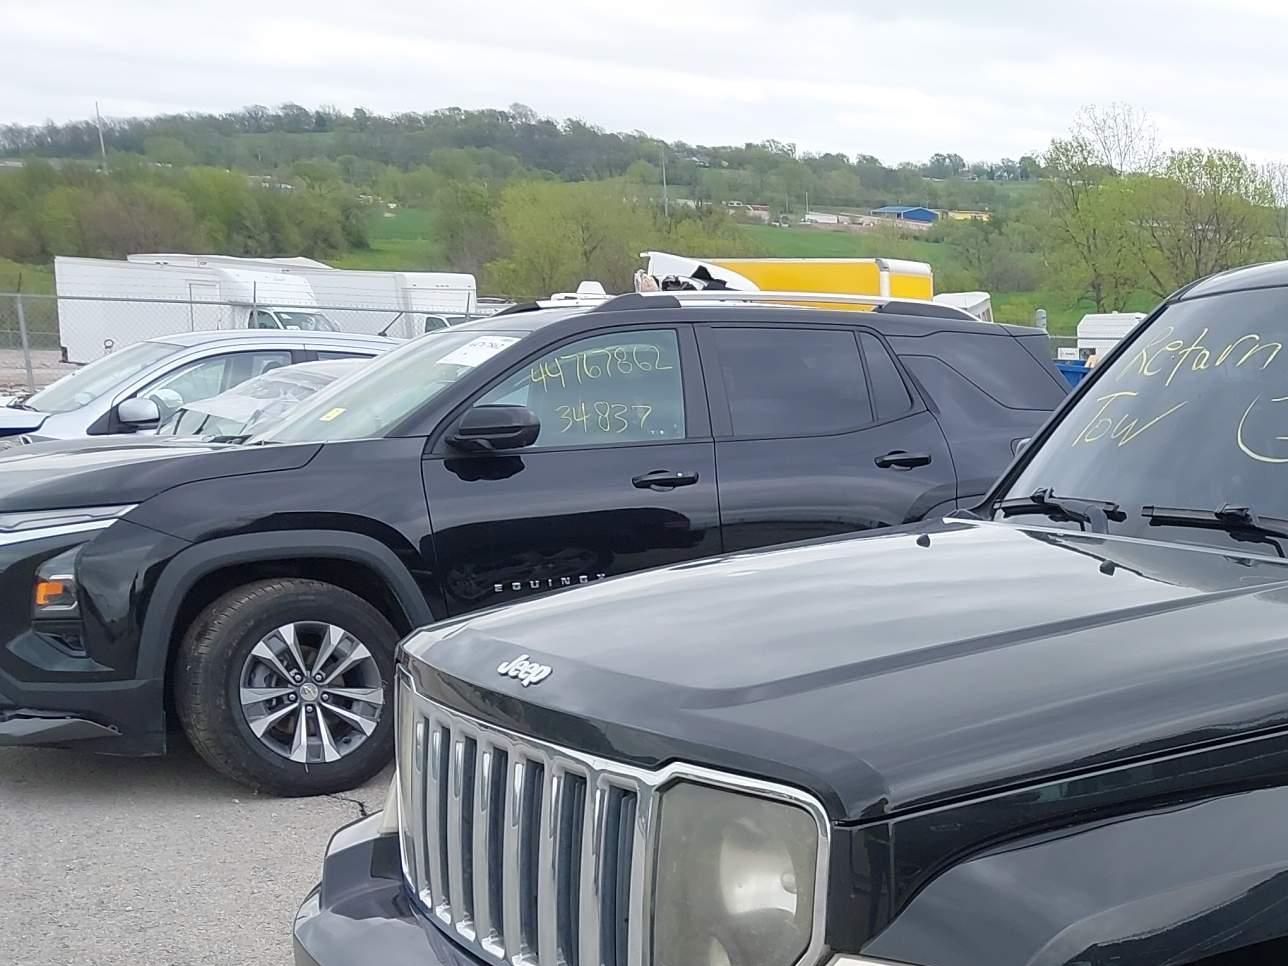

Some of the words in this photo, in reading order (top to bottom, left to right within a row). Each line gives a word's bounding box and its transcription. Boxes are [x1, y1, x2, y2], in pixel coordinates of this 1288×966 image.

[530, 344, 673, 393] 44767862
[555, 401, 652, 433] 34837
[1072, 391, 1189, 447] Tow
[497, 654, 553, 688] Jeep
